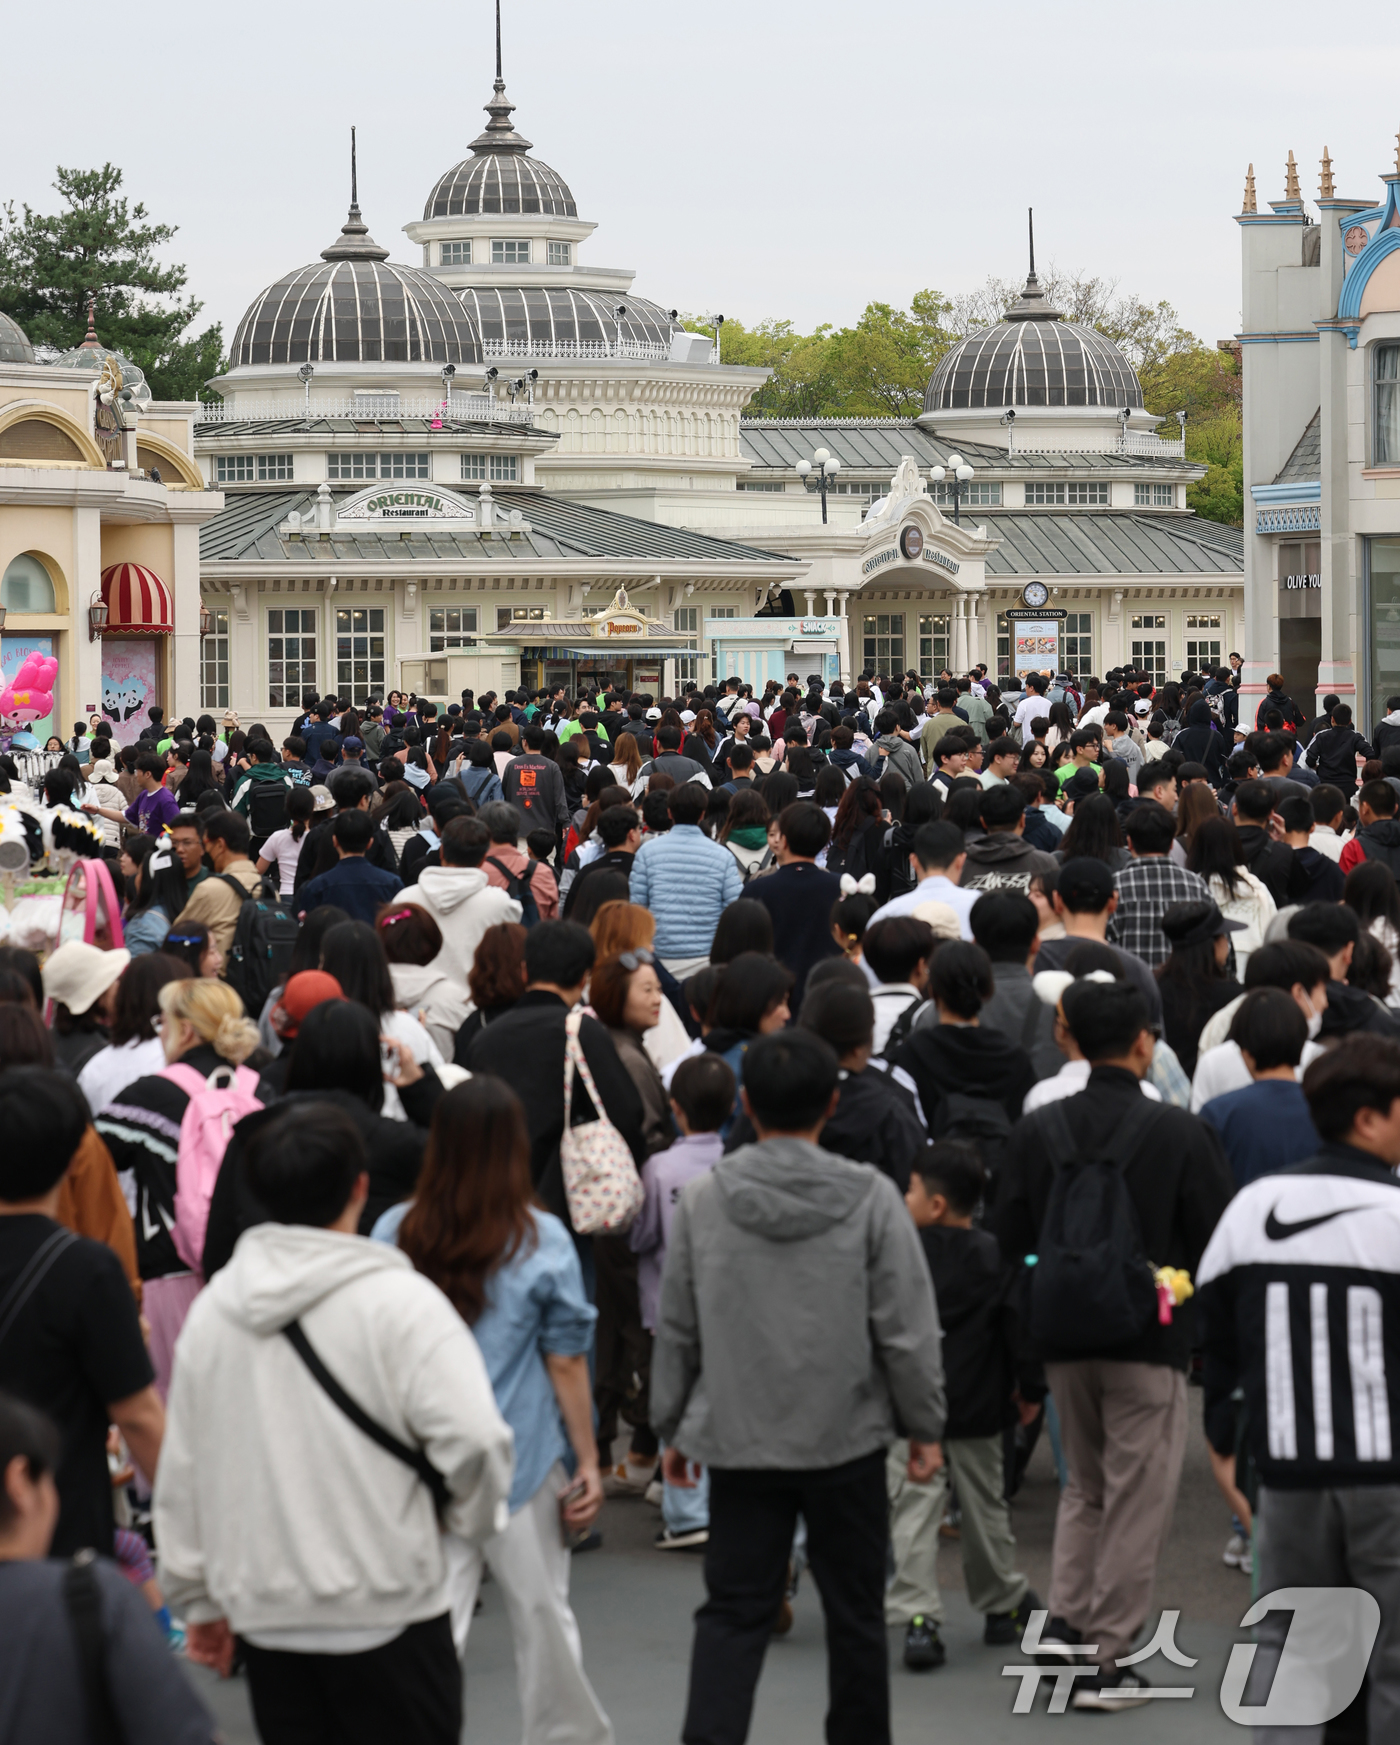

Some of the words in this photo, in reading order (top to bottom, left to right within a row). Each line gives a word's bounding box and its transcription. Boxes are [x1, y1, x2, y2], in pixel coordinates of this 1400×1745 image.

[367, 493, 444, 512] ORIENTAL
[382, 509, 428, 517] Restaurant
[925, 549, 960, 574] Restaurant
[1287, 575, 1307, 589] OLIVE
[606, 621, 638, 637] Popcorn
[802, 621, 827, 634] SNACK
